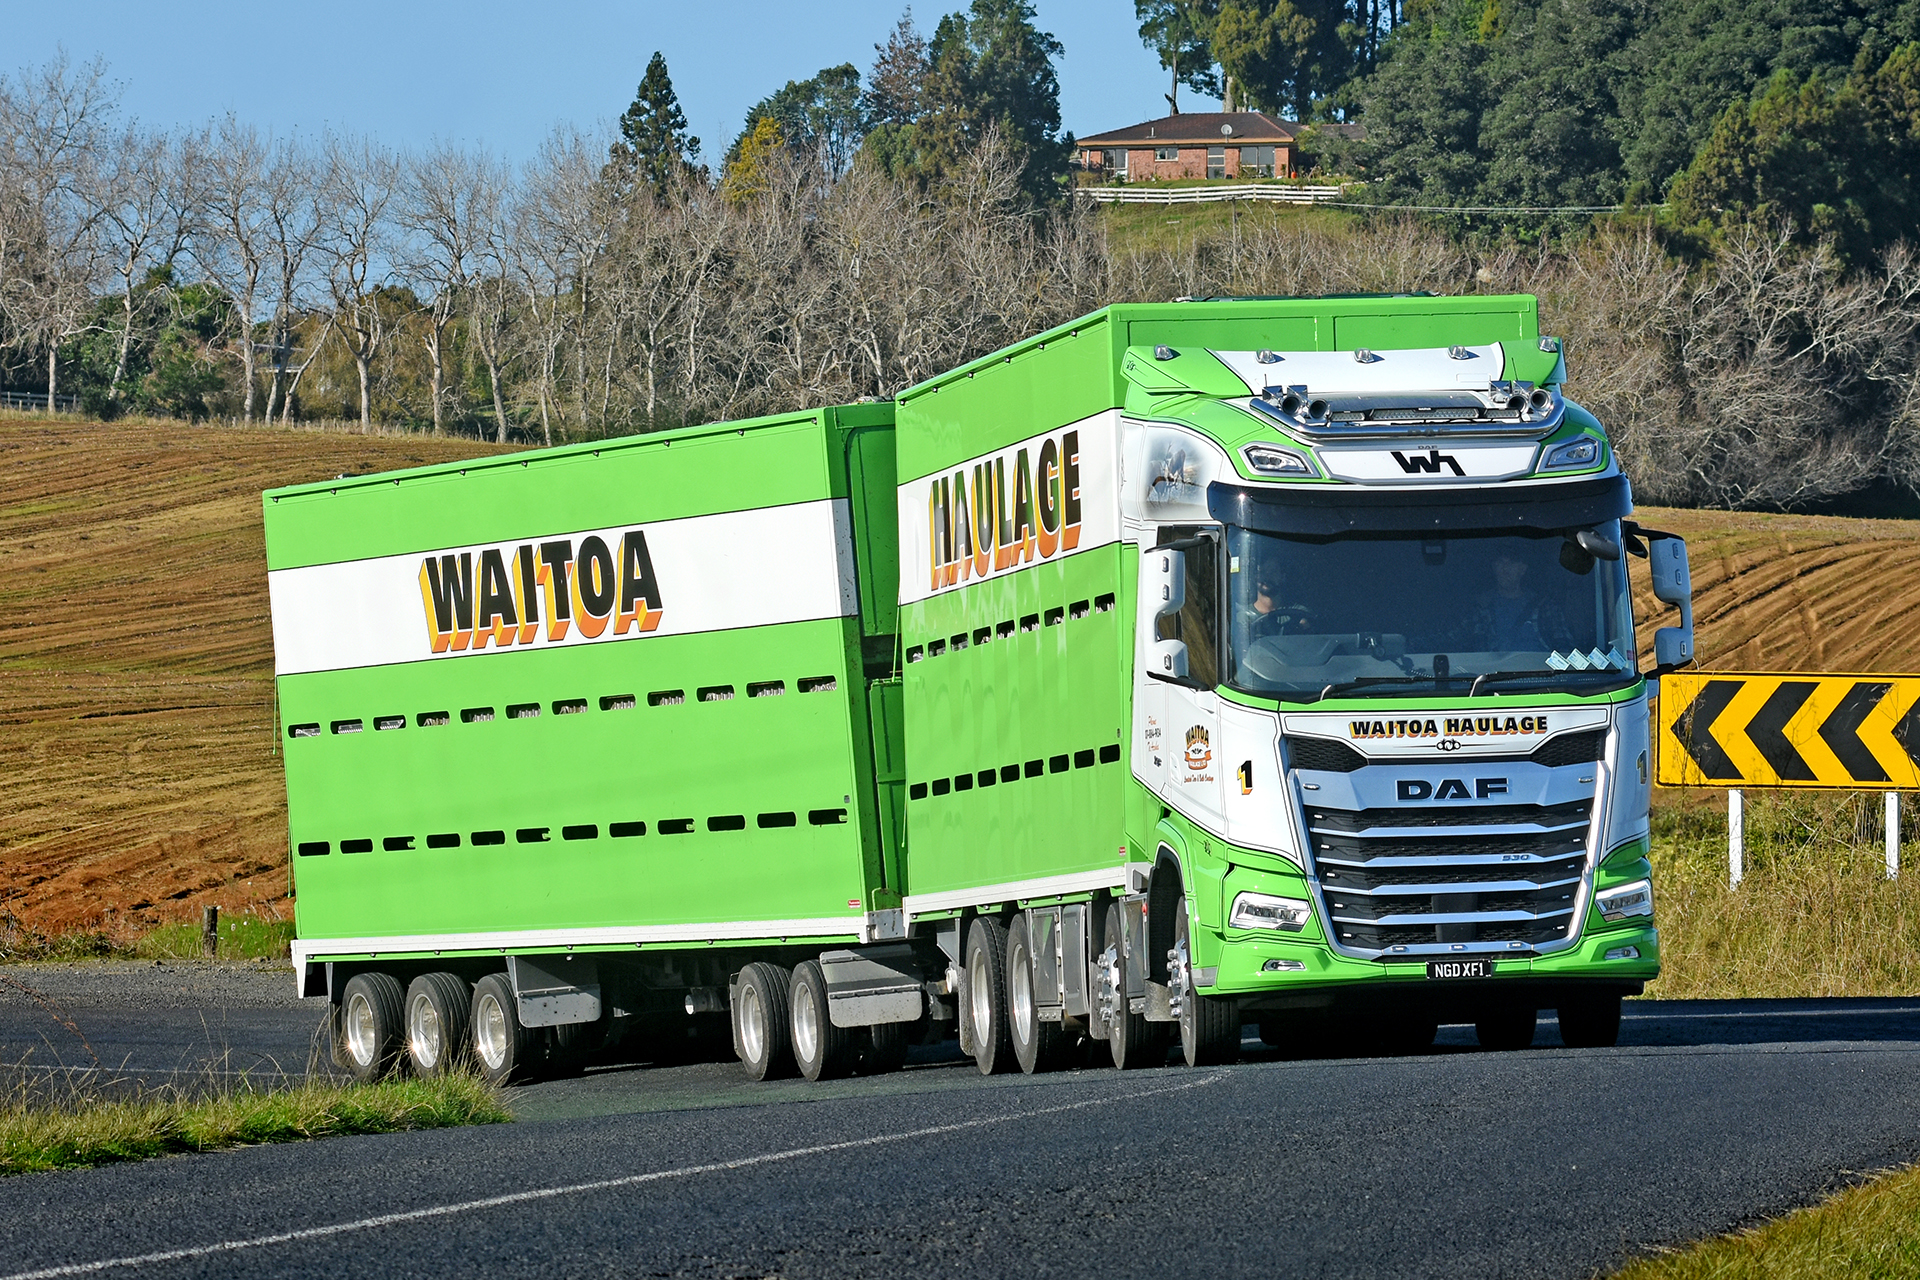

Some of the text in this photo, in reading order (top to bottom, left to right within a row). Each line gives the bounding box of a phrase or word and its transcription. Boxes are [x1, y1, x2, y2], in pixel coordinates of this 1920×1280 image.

[928, 429, 1082, 592] HAULAGE
[418, 530, 663, 653] WAITOA
[1185, 724, 1210, 750] WAITOA
[1349, 715, 1548, 739] WAITOA HAULAGE
[1237, 760, 1253, 795] 1
[1396, 777, 1510, 801] DAF
[1502, 854, 1530, 862] 530
[1435, 962, 1484, 977] NGD XF1
